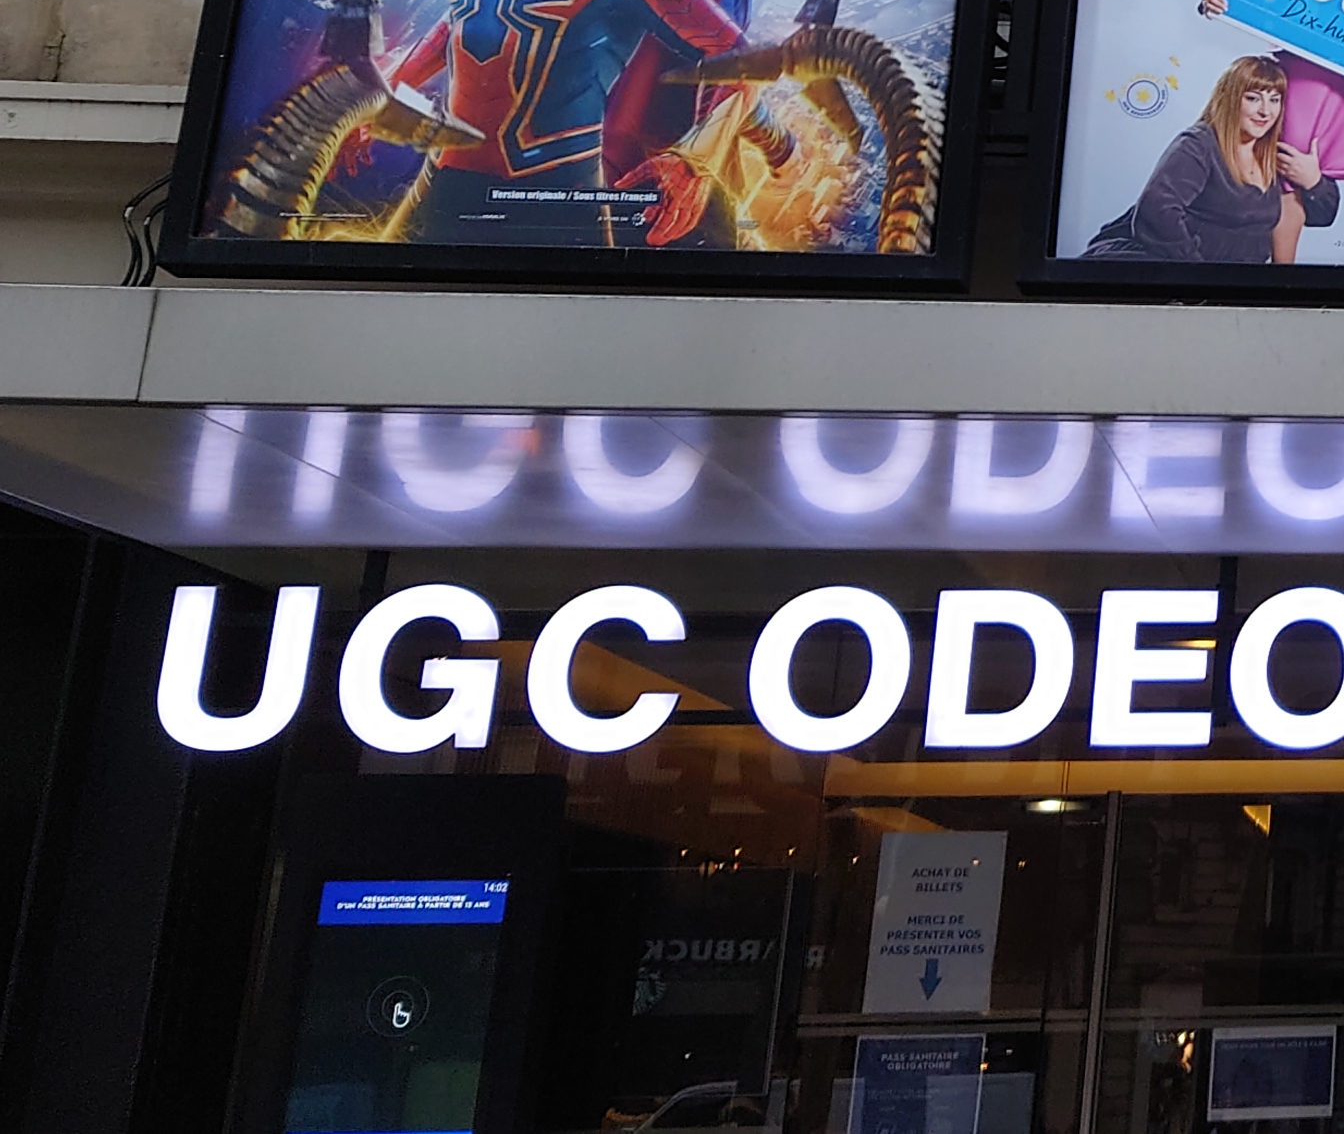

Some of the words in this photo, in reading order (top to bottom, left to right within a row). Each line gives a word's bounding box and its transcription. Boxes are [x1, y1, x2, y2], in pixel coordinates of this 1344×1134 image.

[492, 190, 526, 199] Version
[527, 191, 566, 201] originale
[573, 191, 595, 200] Sous
[620, 193, 658, 203] Français
[154, 582, 687, 753] UGC
[912, 868, 950, 877] ACHAT
[954, 868, 970, 877] DE
[484, 882, 508, 893] 14:02
[916, 882, 963, 892] BILLETS
[907, 915, 945, 925] MERCI
[949, 914, 964, 924] DE
[958, 929, 981, 939] VOS
[880, 945, 910, 955] PASS
[912, 944, 985, 955] SANITAIRES
[881, 1052, 906, 1062] PASS
[909, 1051, 959, 1061] SANITAIRE
[887, 1061, 951, 1071] OBLIGATOIRE
